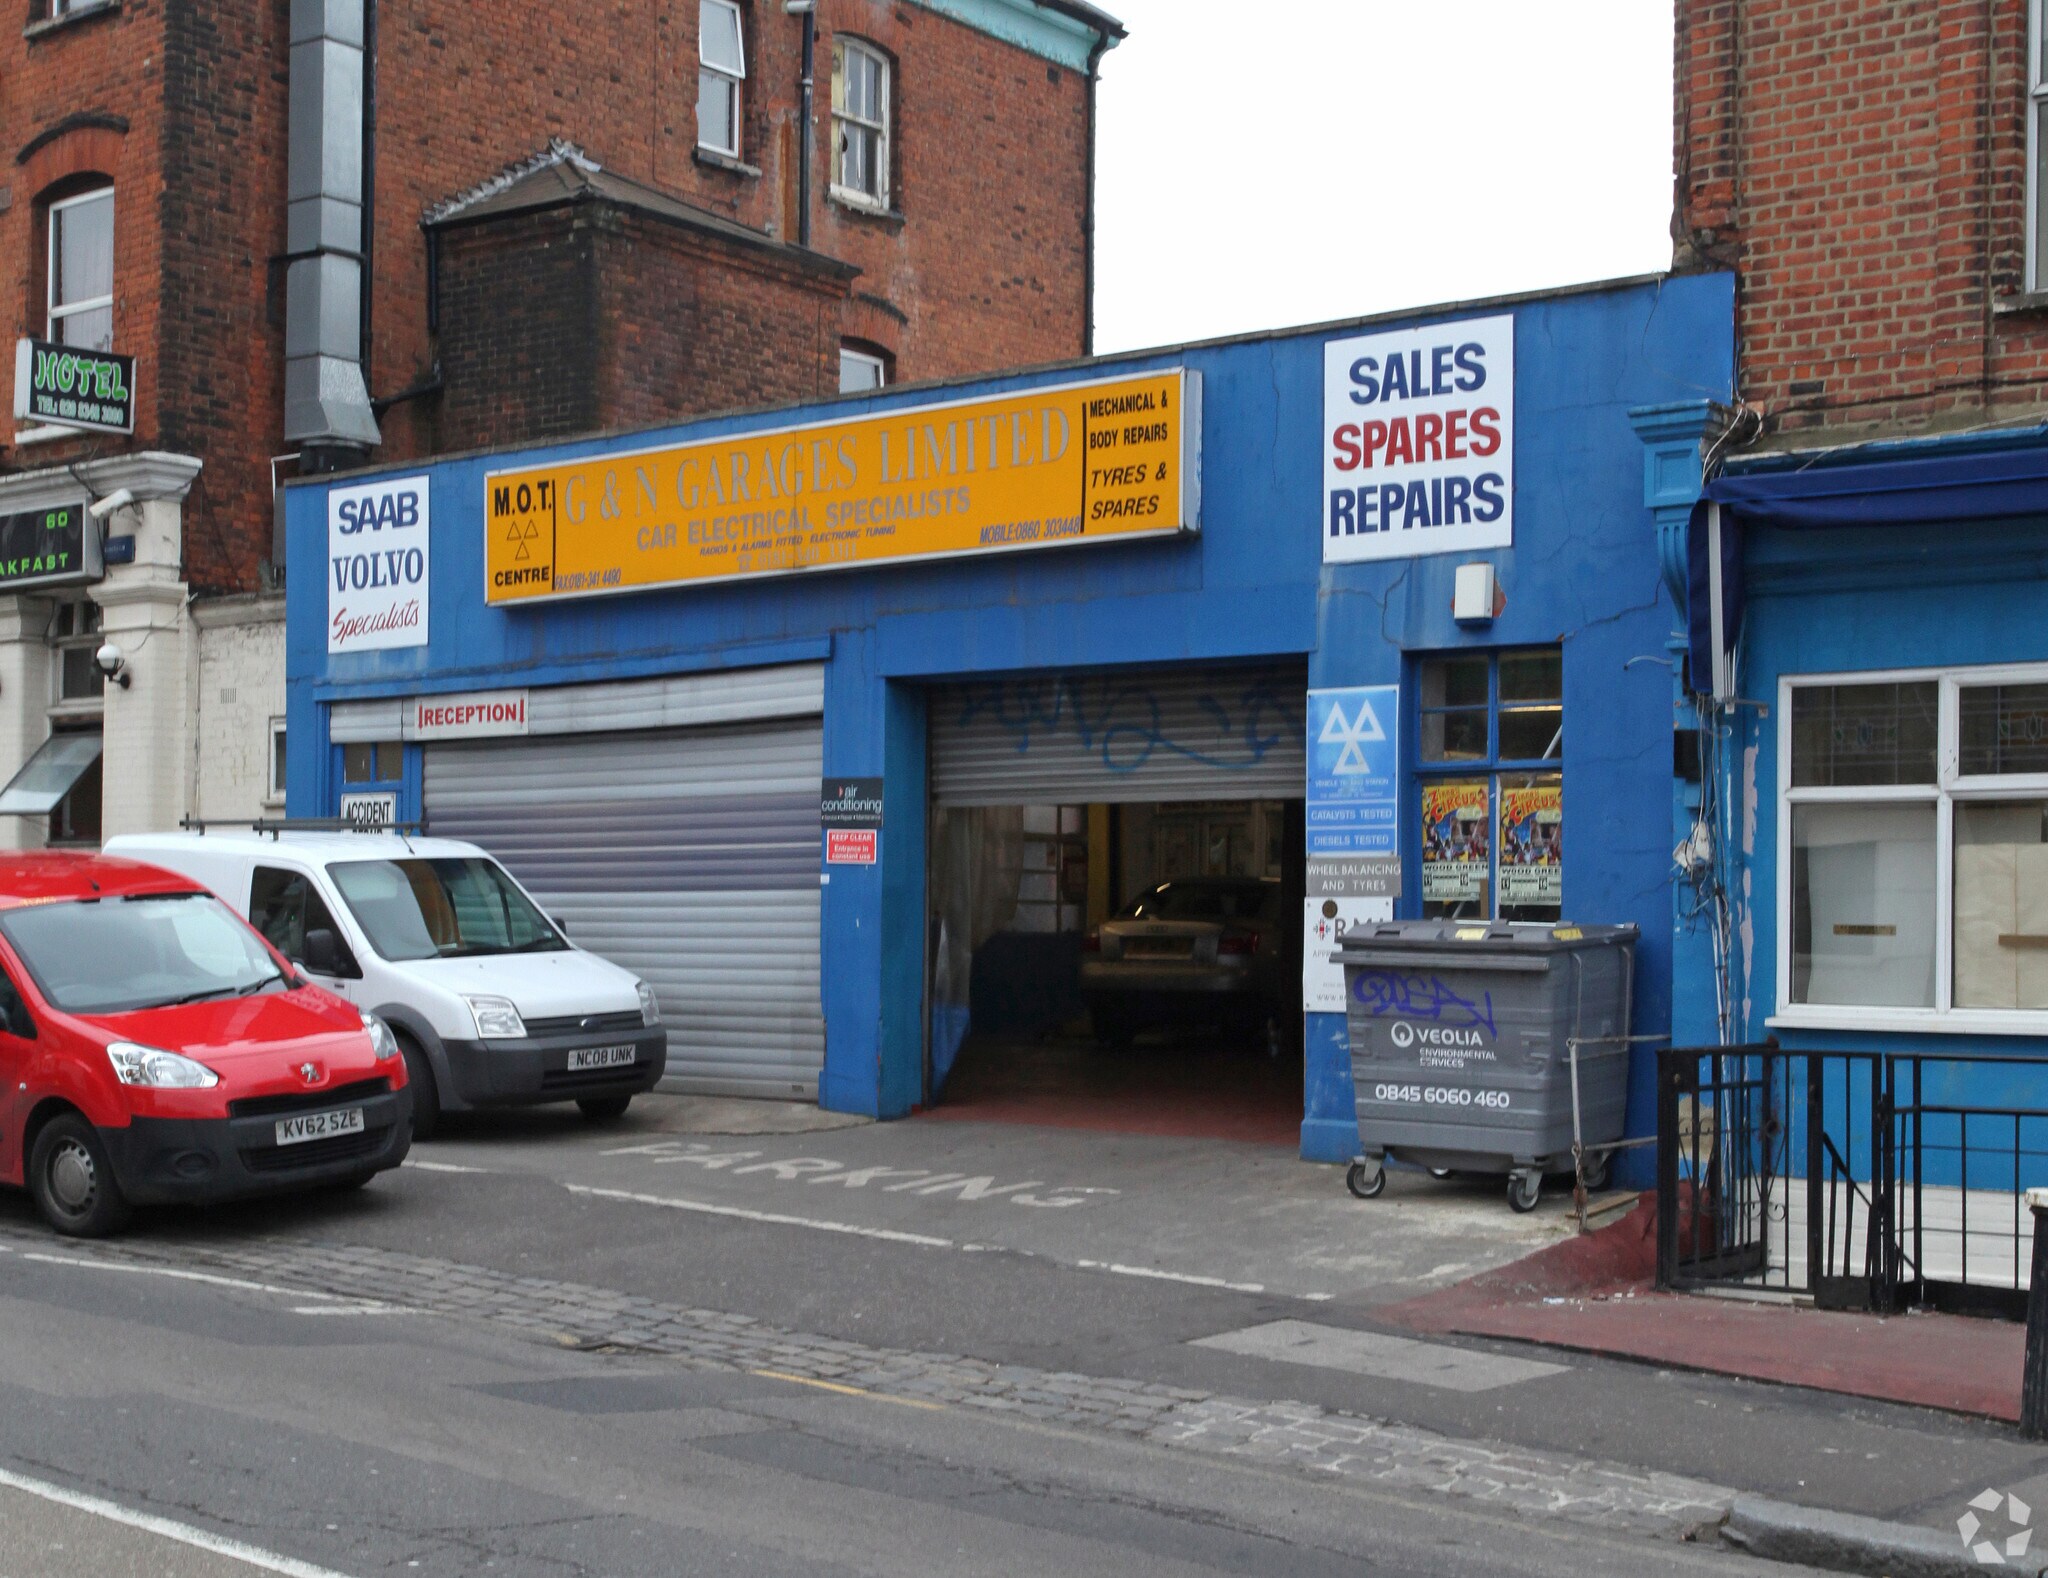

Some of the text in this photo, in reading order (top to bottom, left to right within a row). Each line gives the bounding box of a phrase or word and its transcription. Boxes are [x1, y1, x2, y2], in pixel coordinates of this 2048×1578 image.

[35, 350, 128, 402] HOTEL
[1349, 342, 1487, 405] SALES
[1089, 389, 1169, 419] MECHANICAL &
[1089, 422, 1168, 450] BODY REPAIRS
[1333, 406, 1501, 472] SPARES
[565, 406, 1070, 526] G & N GARAGES LIMITED
[1091, 462, 1167, 489] TYRES &
[494, 480, 552, 518] M.O.T.
[1091, 495, 1160, 521] SPARES
[1329, 472, 1505, 537] REPAIRS
[338, 490, 419, 535] SAAB
[636, 485, 970, 552] CAR ELECTRICAL SPECIALISTS
[741, 539, 773, 552] ALARMS
[775, 535, 803, 547] FITTED
[810, 529, 861, 543] ELECTRONIC
[332, 547, 424, 593] VOLVO
[494, 566, 550, 587] CENTRE
[332, 598, 420, 645] Specialists
[424, 703, 517, 727] RECEPTION
[844, 784, 858, 799] air
[346, 801, 391, 823] ACCIDENT
[821, 797, 882, 815] conditioning
[1311, 808, 1392, 820] CATALYSTS TESTED
[831, 833, 848, 842] KEEP
[1314, 834, 1389, 847] DIESELS TESTED
[1307, 863, 1401, 876] WHEEL BALANCING
[1424, 864, 1453, 872] WOOD
[1322, 879, 1386, 891] AND TYRES
[1416, 1028, 1483, 1047] VEOLIA
[576, 1046, 633, 1066] NC08 UNK
[1419, 1047, 1497, 1061] ENVIRONMENTAL
[1419, 1057, 1464, 1068] SERVICES
[1375, 1083, 1510, 1108] 0845 6060 460
[284, 1109, 358, 1138] KV62 SZE
[600, 1142, 1120, 1208] PARKING
